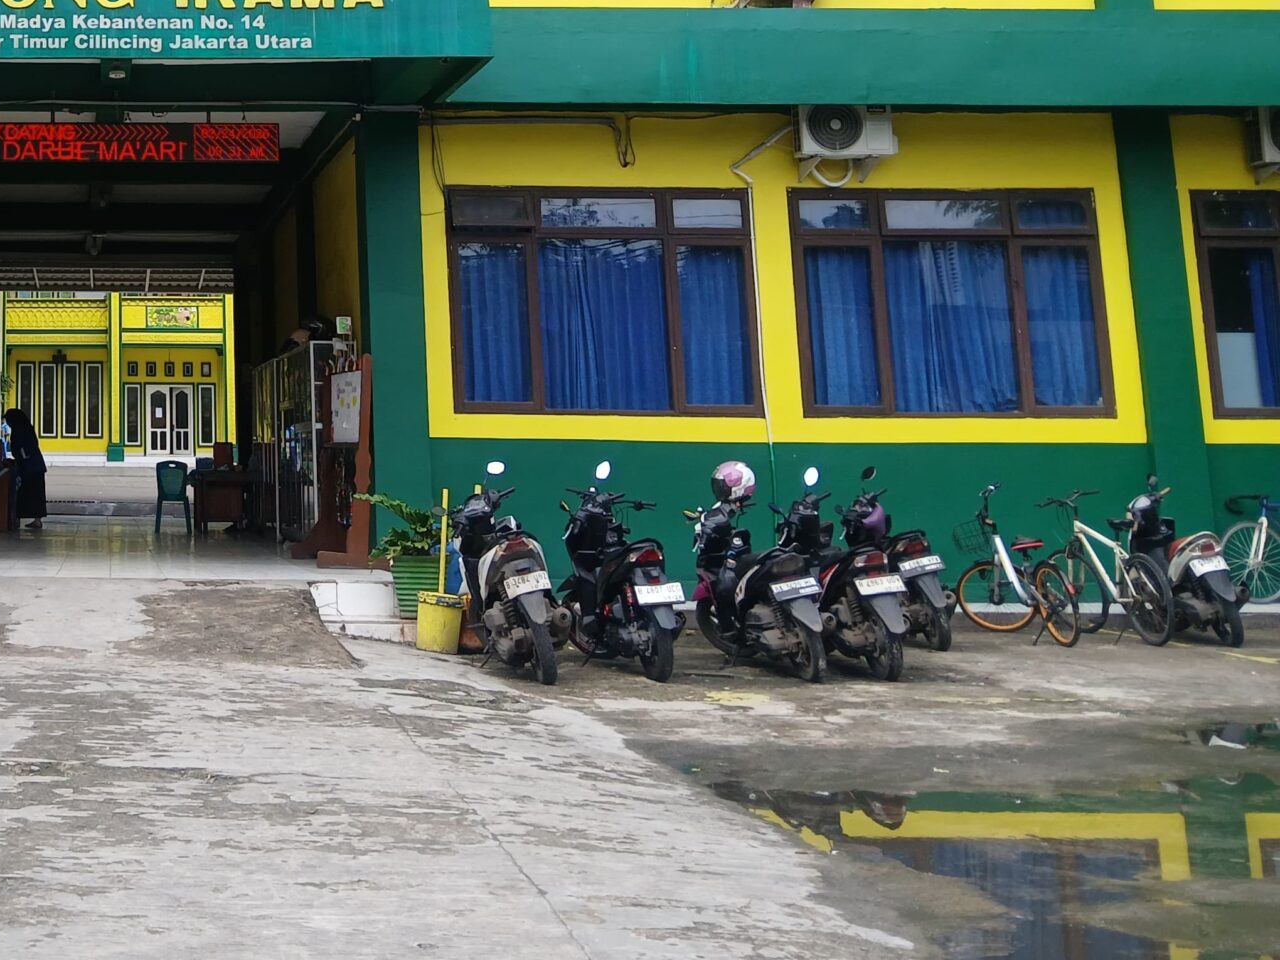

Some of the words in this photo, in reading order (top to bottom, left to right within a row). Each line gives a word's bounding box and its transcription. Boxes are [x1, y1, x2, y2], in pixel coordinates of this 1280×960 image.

[72, 14, 194, 30] Kebantenan
[200, 15, 235, 30] No.
[241, 15, 265, 30] 14
[9, 34, 69, 50] Timur
[74, 34, 163, 53] Cilincing
[169, 34, 249, 50] Jakarta
[255, 34, 313, 50] Utara
